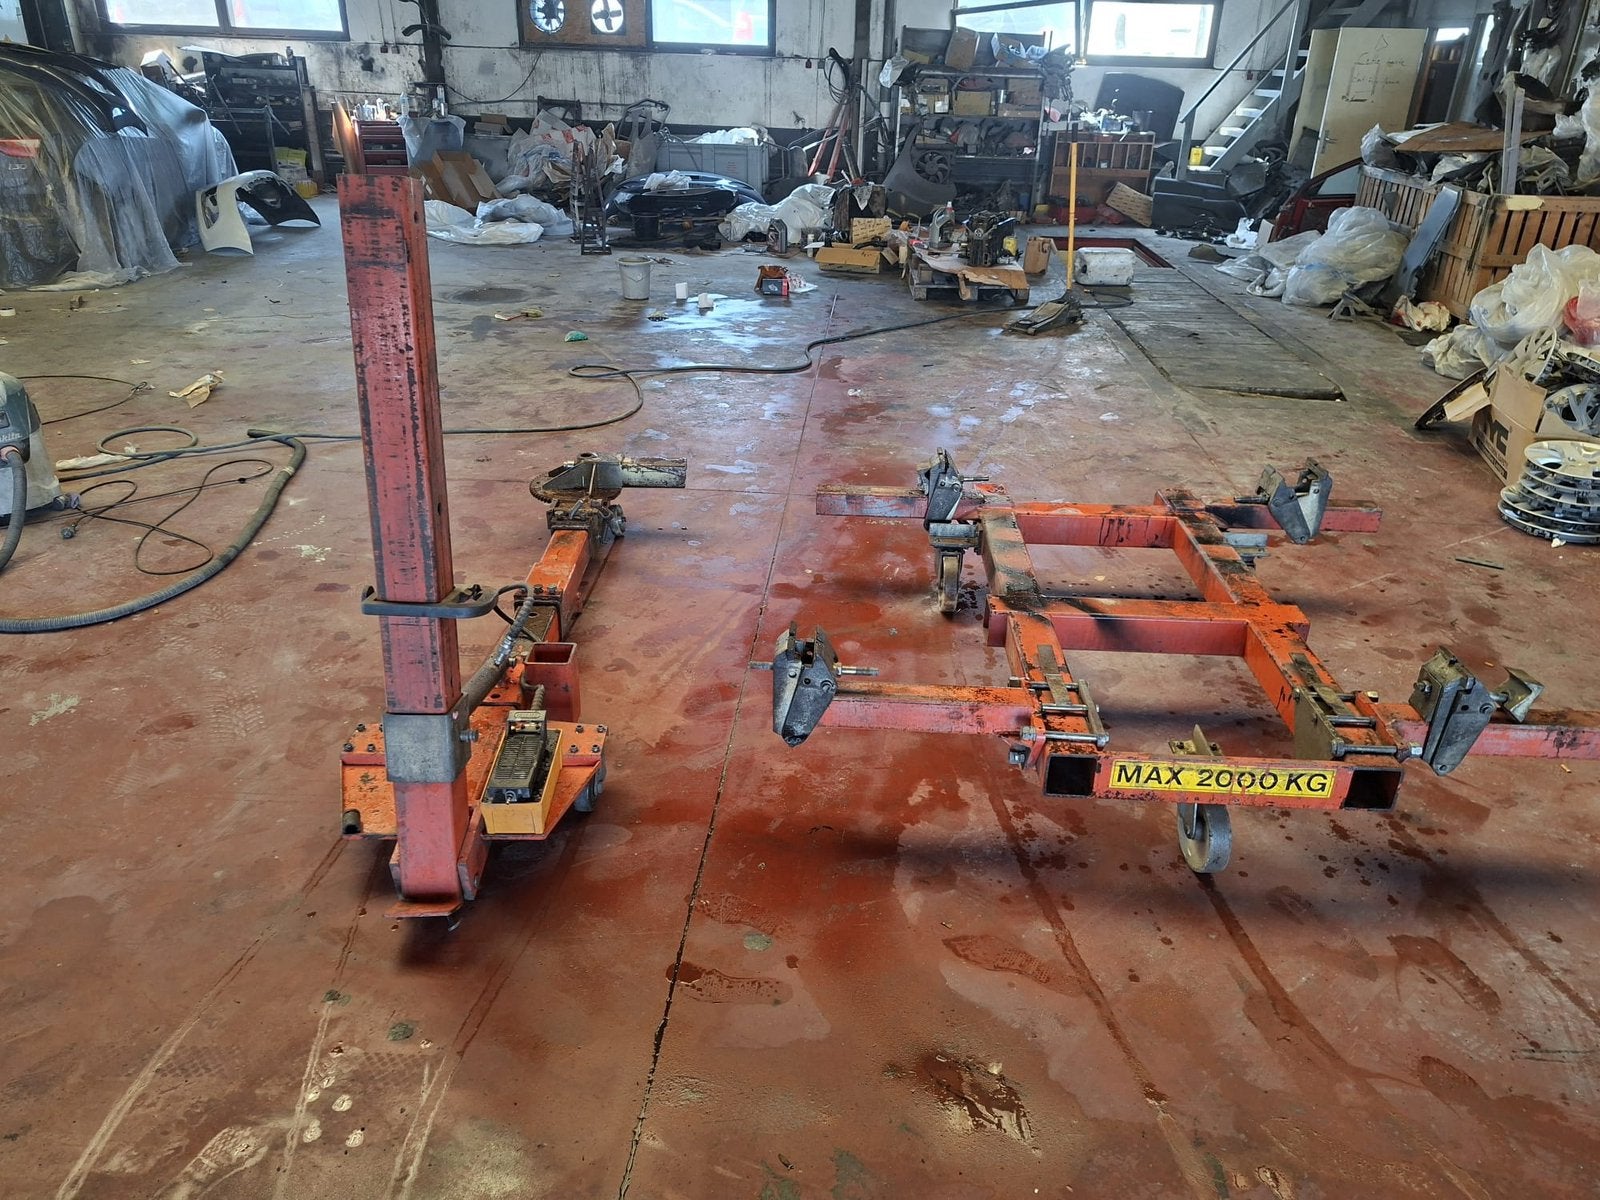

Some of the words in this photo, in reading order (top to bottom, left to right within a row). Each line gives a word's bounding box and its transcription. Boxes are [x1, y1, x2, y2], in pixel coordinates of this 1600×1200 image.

[1116, 764, 1185, 786] MAX
[1196, 768, 1279, 791] 2000
[1285, 772, 1328, 793] KG
